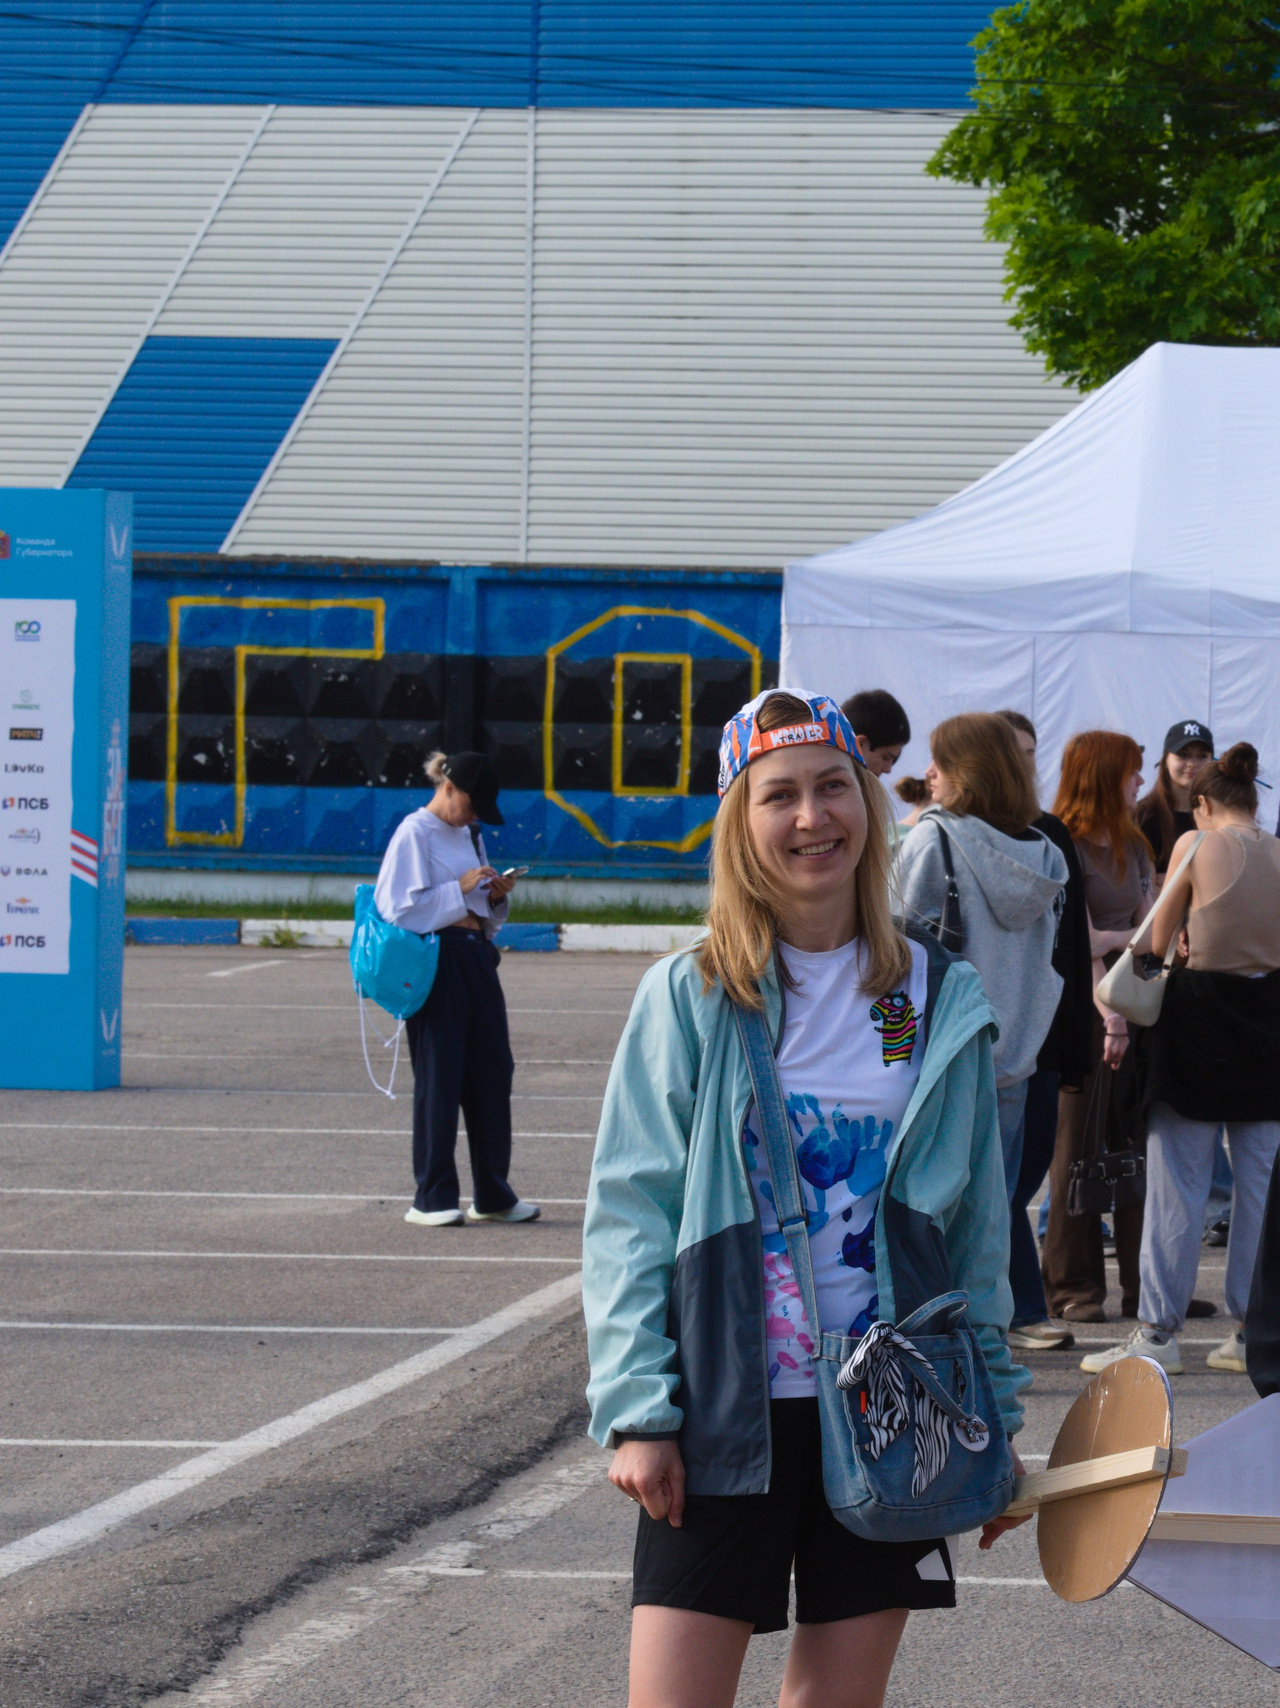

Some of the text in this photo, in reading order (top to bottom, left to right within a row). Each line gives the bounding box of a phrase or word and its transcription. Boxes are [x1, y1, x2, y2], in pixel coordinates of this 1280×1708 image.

[16, 537, 56, 546] Команда
[16, 548, 73, 558] Губернатора
[1184, 723, 1200, 736] NY
[779, 731, 816, 743] TRAIL
[18, 797, 49, 810] ПСБ
[16, 867, 48, 876] ВФЛА
[14, 935, 46, 948] ПСБ
